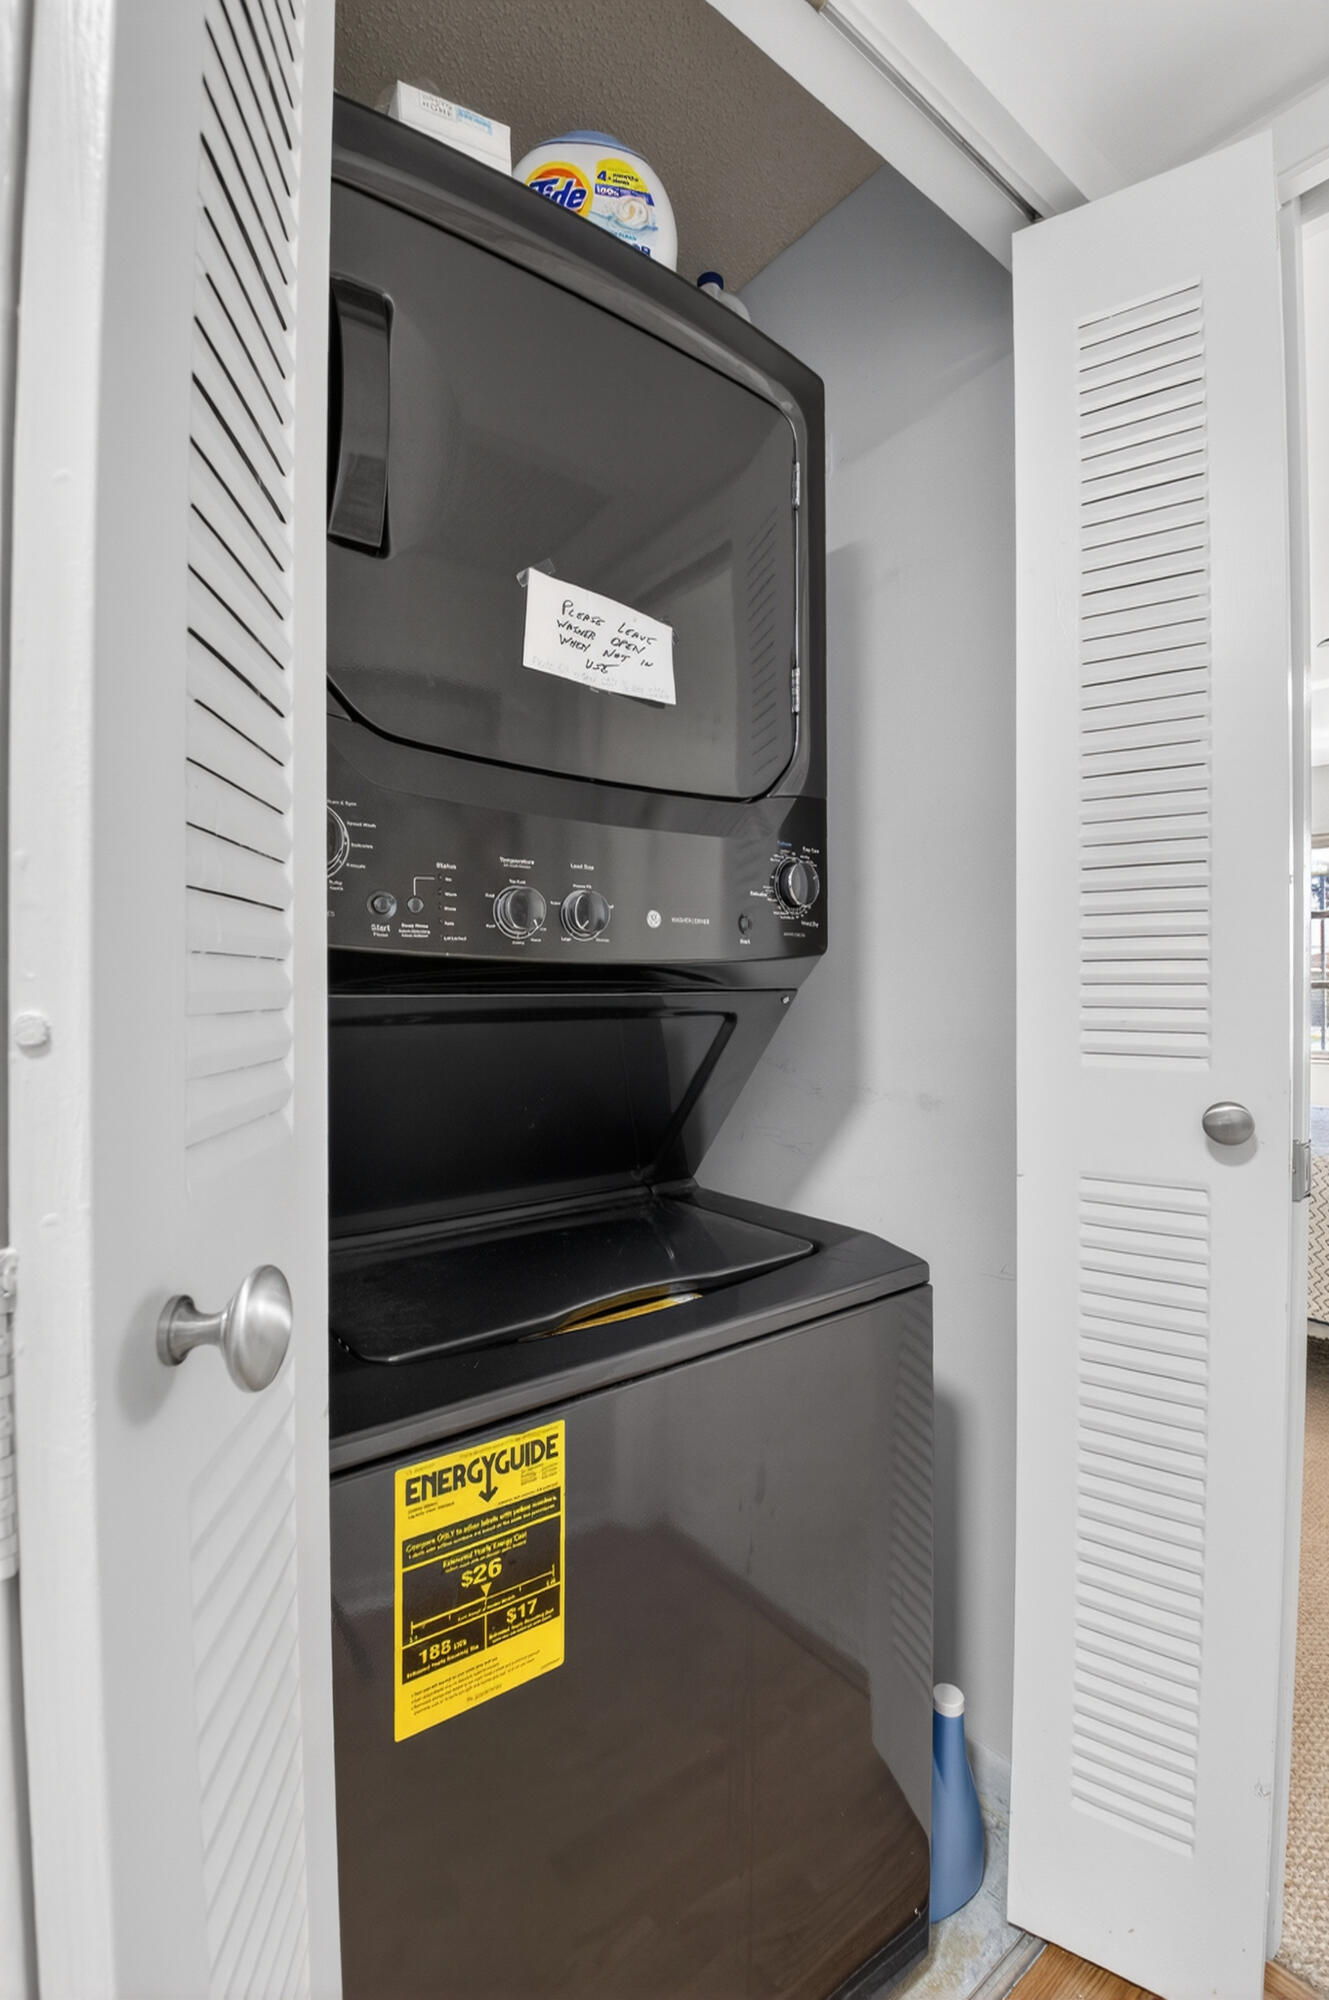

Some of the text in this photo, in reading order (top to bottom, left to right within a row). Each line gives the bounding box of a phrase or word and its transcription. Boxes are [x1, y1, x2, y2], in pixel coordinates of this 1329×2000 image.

[597, 170, 607, 181] 4
[529, 177, 587, 208] Tide
[561, 599, 657, 644] PLEASE LEAVE
[557, 619, 645, 654] WASHER OPEN
[559, 634, 653, 667] WHEN NOT IN
[586, 659, 619, 673] USE
[436, 862, 457, 870] Status
[500, 857, 535, 865] Temperature
[371, 923, 390, 932] Start
[405, 1433, 559, 1506] ENERGYGUIDE
[437, 1528, 455, 1542] ONLY
[481, 1514, 499, 1528] labels
[461, 1558, 503, 1588] $26
[507, 1598, 538, 1624] $17
[419, 1639, 451, 1665] 188
